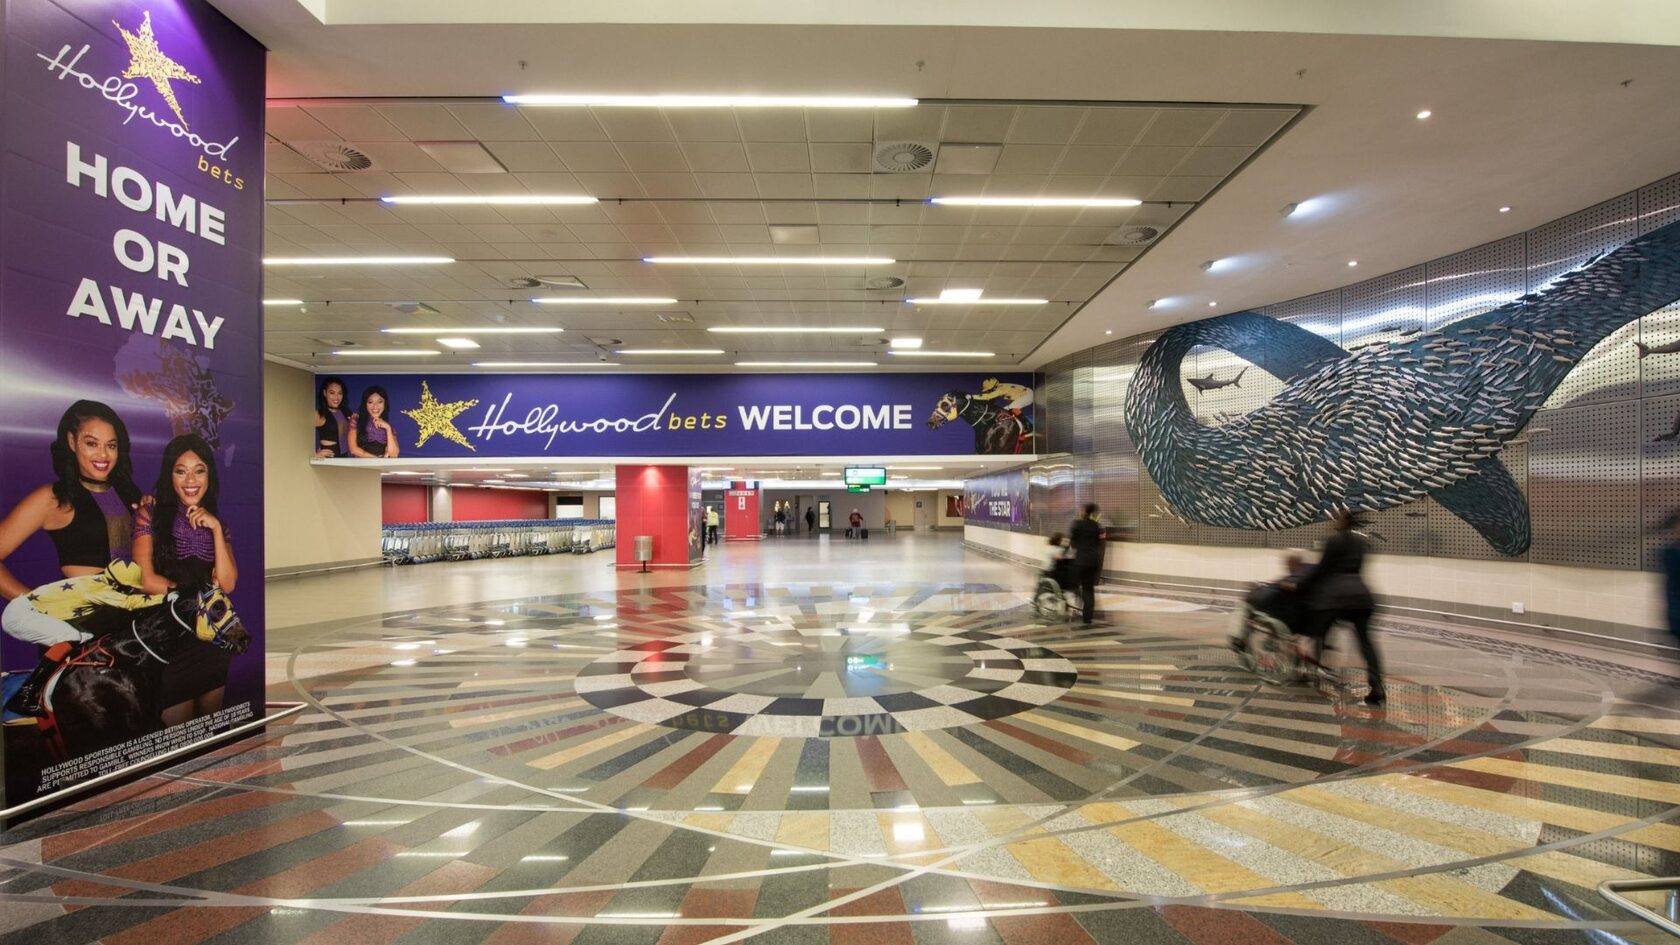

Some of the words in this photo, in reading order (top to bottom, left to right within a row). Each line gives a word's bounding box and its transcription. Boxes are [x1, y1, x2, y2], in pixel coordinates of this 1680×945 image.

[37, 44, 240, 161] Hollywood
[66, 140, 225, 246] HOME
[197, 155, 244, 190] bets
[113, 228, 189, 287] OR
[66, 277, 225, 350] AWAY
[468, 392, 677, 450] Hollywood
[667, 412, 727, 430] bets
[738, 404, 912, 430] WELCOME
[36, 781, 52, 793] ARE
[52, 770, 89, 787] PMITTED
[89, 766, 98, 774] TO
[128, 746, 154, 760] WINNERS
[154, 740, 170, 750] KNOW
[171, 734, 187, 745] WHEN
[41, 757, 83, 776] HOLLYWOOD
[84, 744, 126, 762] SPORTSBOOK
[138, 730, 164, 743] LICENSED
[164, 722, 185, 735] BETTING
[42, 766, 78, 783] SUPPORTS
[79, 750, 122, 770] RESPONSIBLE
[162, 728, 187, 741] PERSONS
[187, 723, 204, 733] UNDER
[205, 719, 213, 727] THE
[214, 716, 223, 724] AGE
